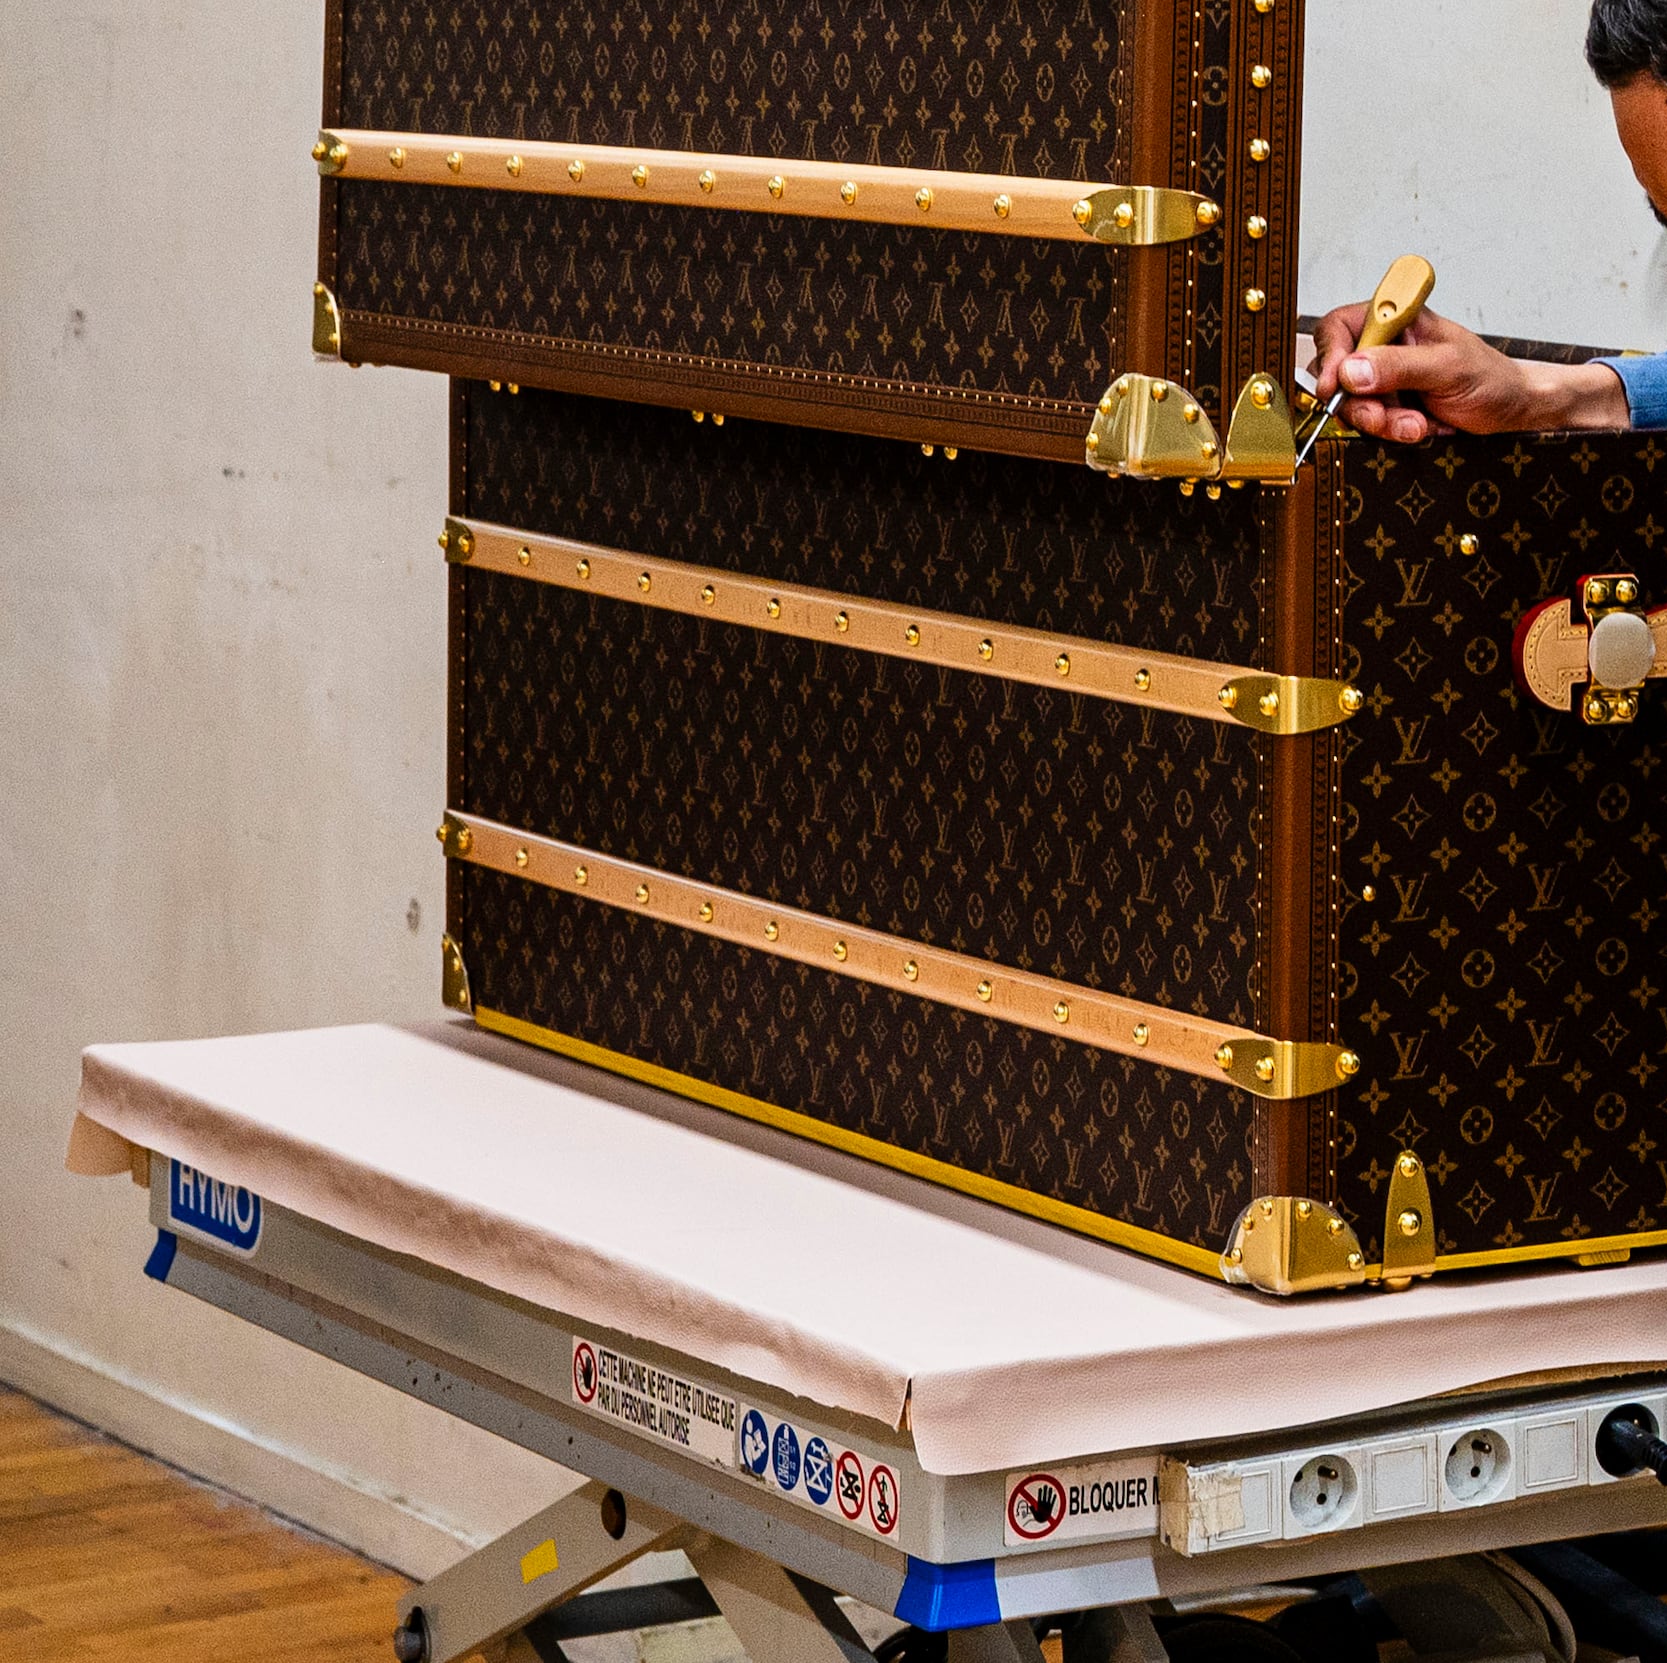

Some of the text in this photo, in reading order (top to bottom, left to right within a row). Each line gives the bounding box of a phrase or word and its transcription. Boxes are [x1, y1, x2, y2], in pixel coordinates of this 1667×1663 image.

[179, 1162, 255, 1234] HYMO
[598, 1349, 735, 1432] CETTE MACHINE NE PEUT ETRE UTILISEE QUE
[598, 1381, 610, 1412] PAR
[611, 1387, 620, 1416] DU
[621, 1391, 658, 1432] PERSONNEL
[1069, 1476, 1148, 1515] BLOQUER
